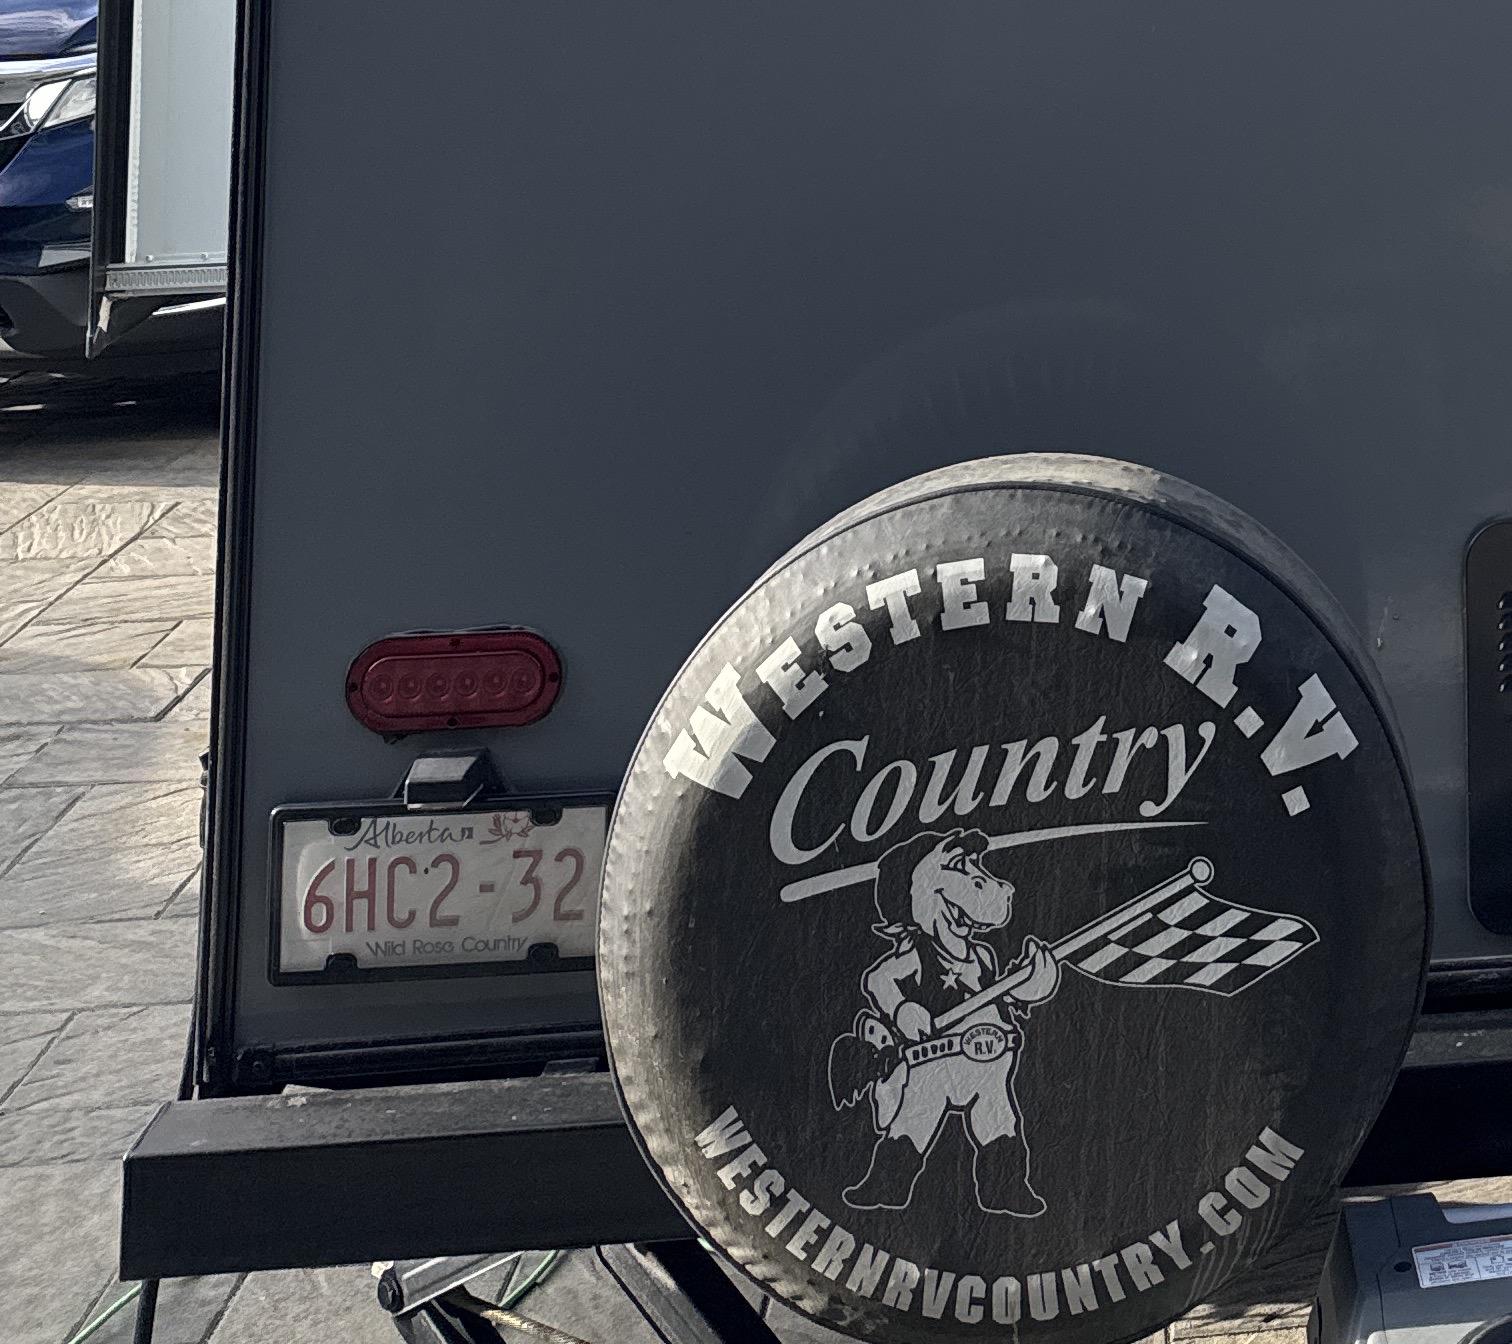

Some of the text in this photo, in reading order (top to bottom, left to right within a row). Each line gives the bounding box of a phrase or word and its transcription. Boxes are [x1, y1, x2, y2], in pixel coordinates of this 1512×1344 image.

[662, 553, 1360, 817] WESTERN R.V.
[769, 714, 1216, 866] Country
[344, 817, 462, 852] Alberta
[303, 847, 586, 934] 6HC2-32
[366, 935, 529, 958] Wild Rose Country
[964, 1028, 1004, 1046] WESTERN
[694, 1105, 1303, 1325] WESTERNRVCOUNTRY.COM
